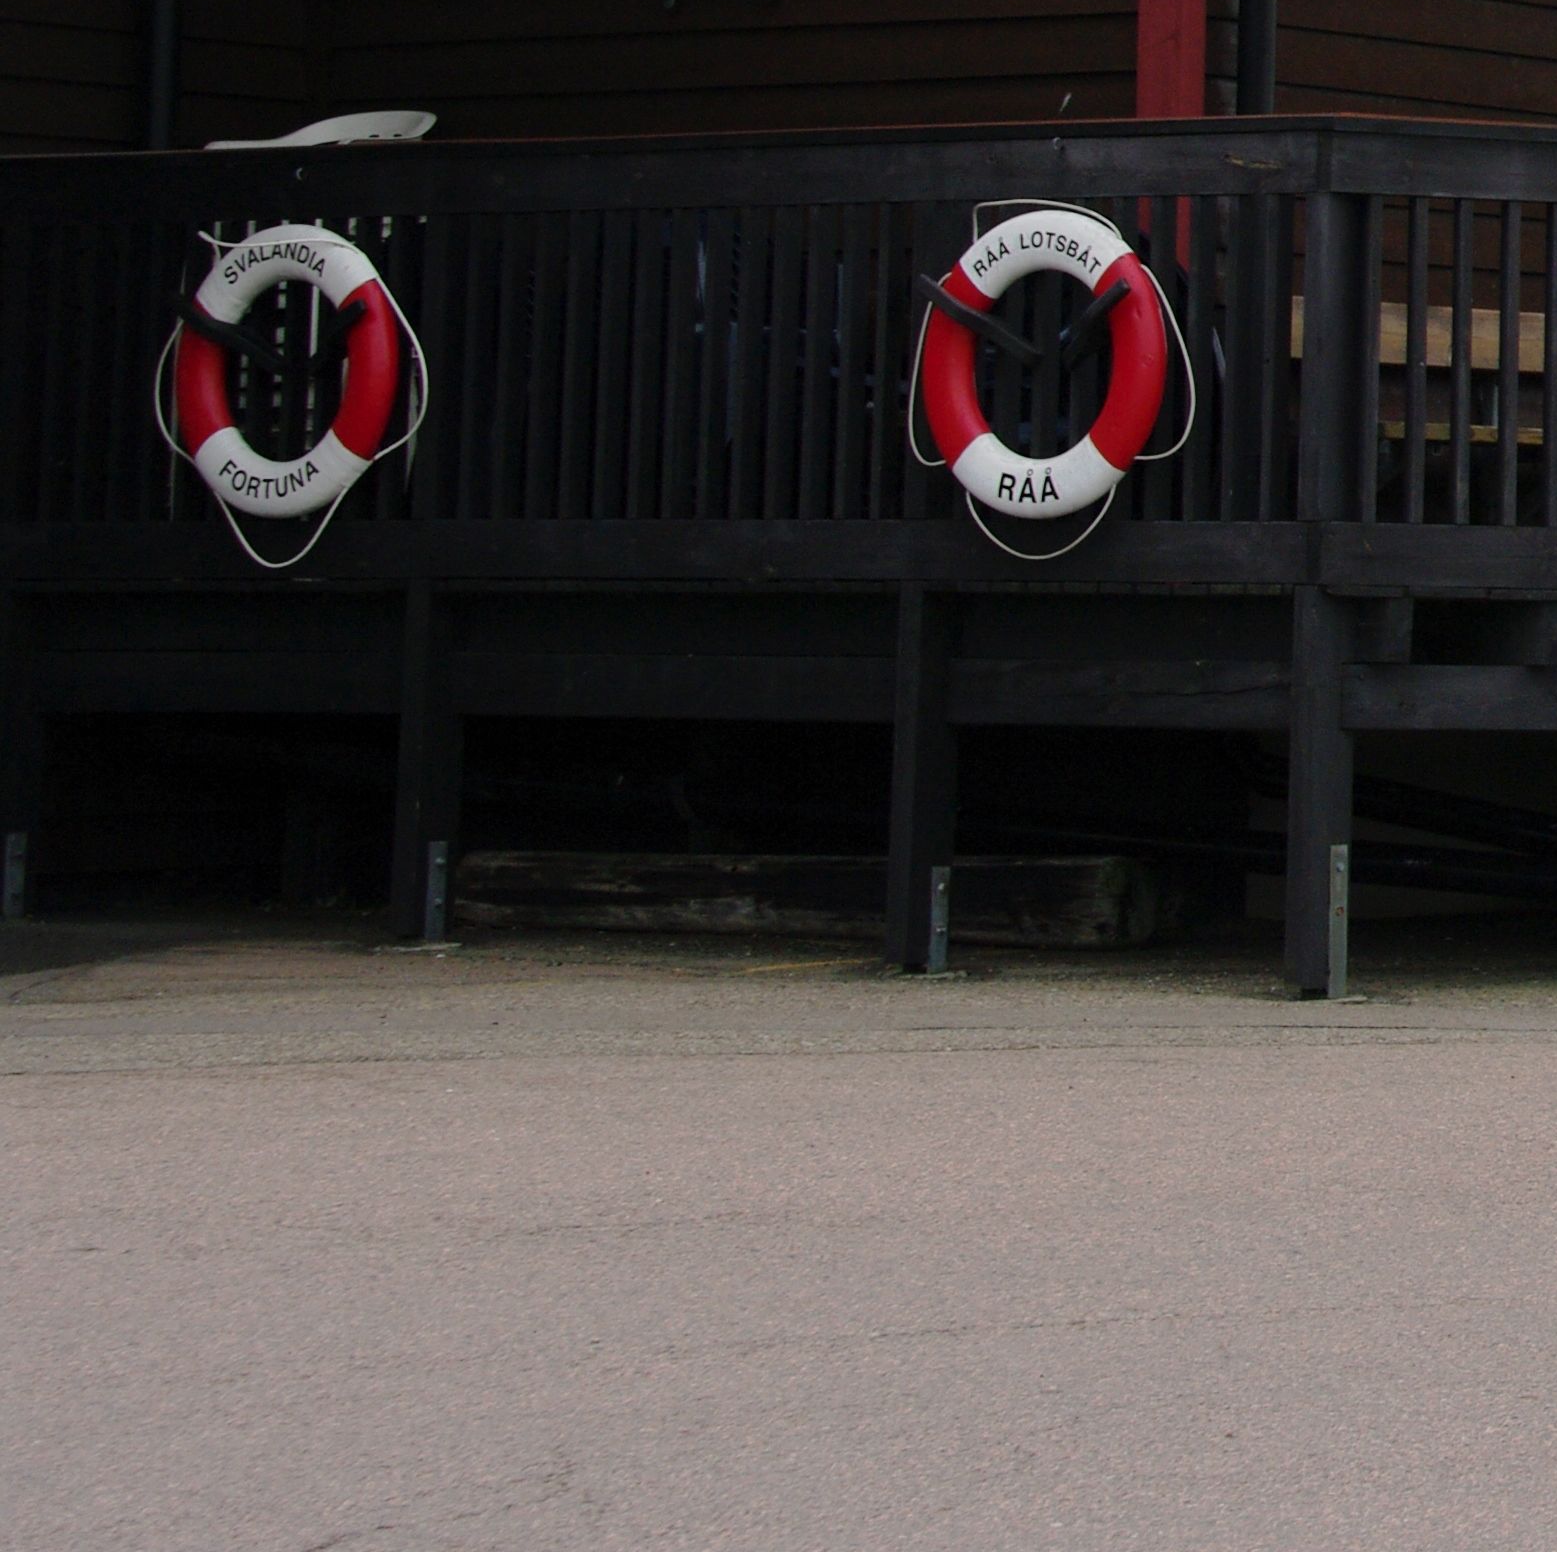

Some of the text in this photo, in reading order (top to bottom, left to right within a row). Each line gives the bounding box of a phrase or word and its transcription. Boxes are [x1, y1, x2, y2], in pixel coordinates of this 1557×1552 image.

[224, 242, 326, 285] SVALANDIA
[973, 230, 1102, 278] RÅÅ LOTSBÅT
[219, 459, 320, 499] FORTUNA
[998, 466, 1060, 504] RÅÅ
